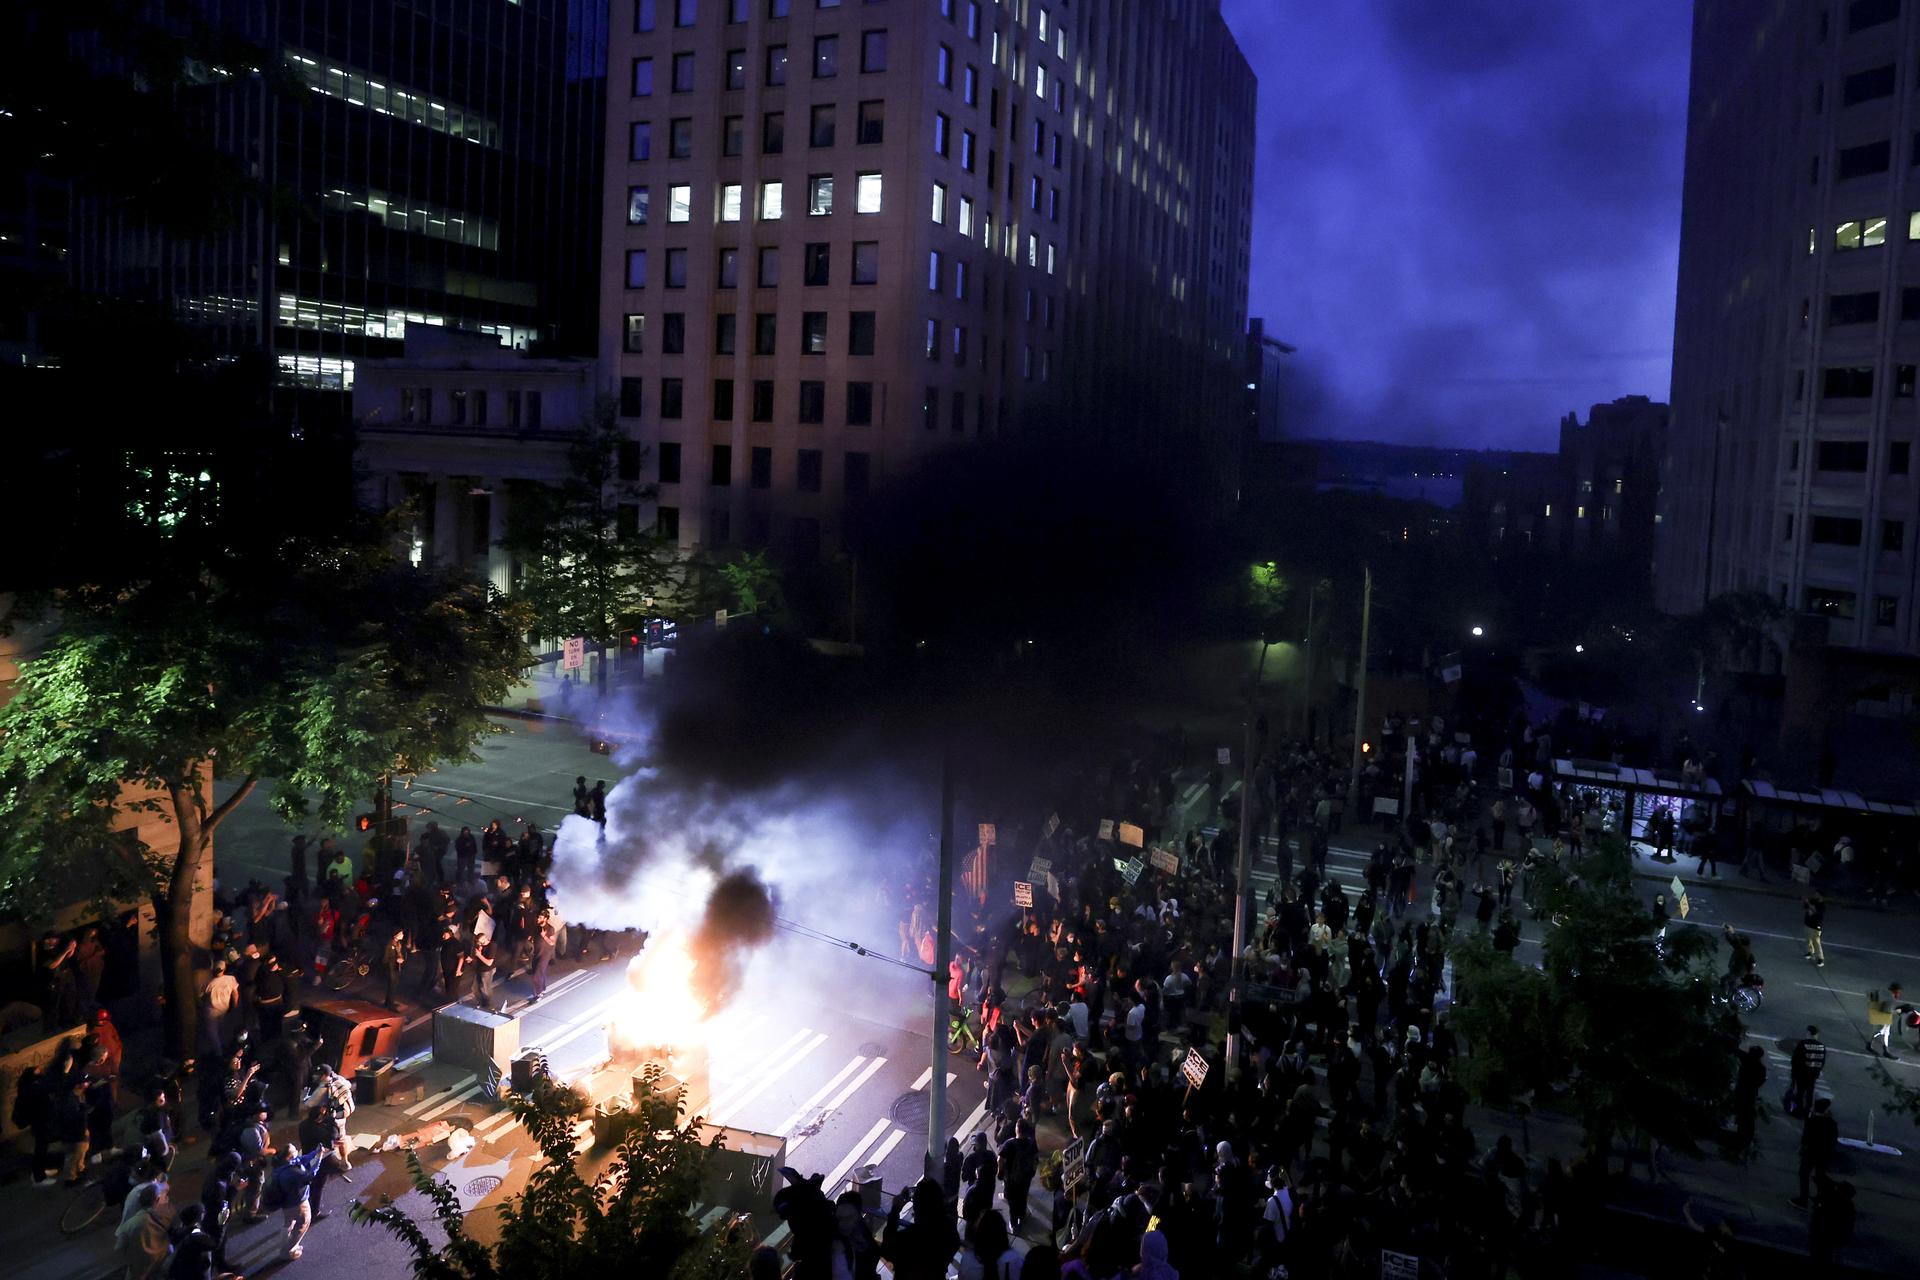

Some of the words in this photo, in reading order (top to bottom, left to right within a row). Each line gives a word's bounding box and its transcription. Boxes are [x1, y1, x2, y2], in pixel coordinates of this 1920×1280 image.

[1015, 883, 1031, 891] ICE
[1190, 1050, 1208, 1073] ICE
[1183, 1067, 1201, 1087] NOW
[1065, 1140, 1083, 1166] STOP
[1384, 1252, 1417, 1270] ICE
